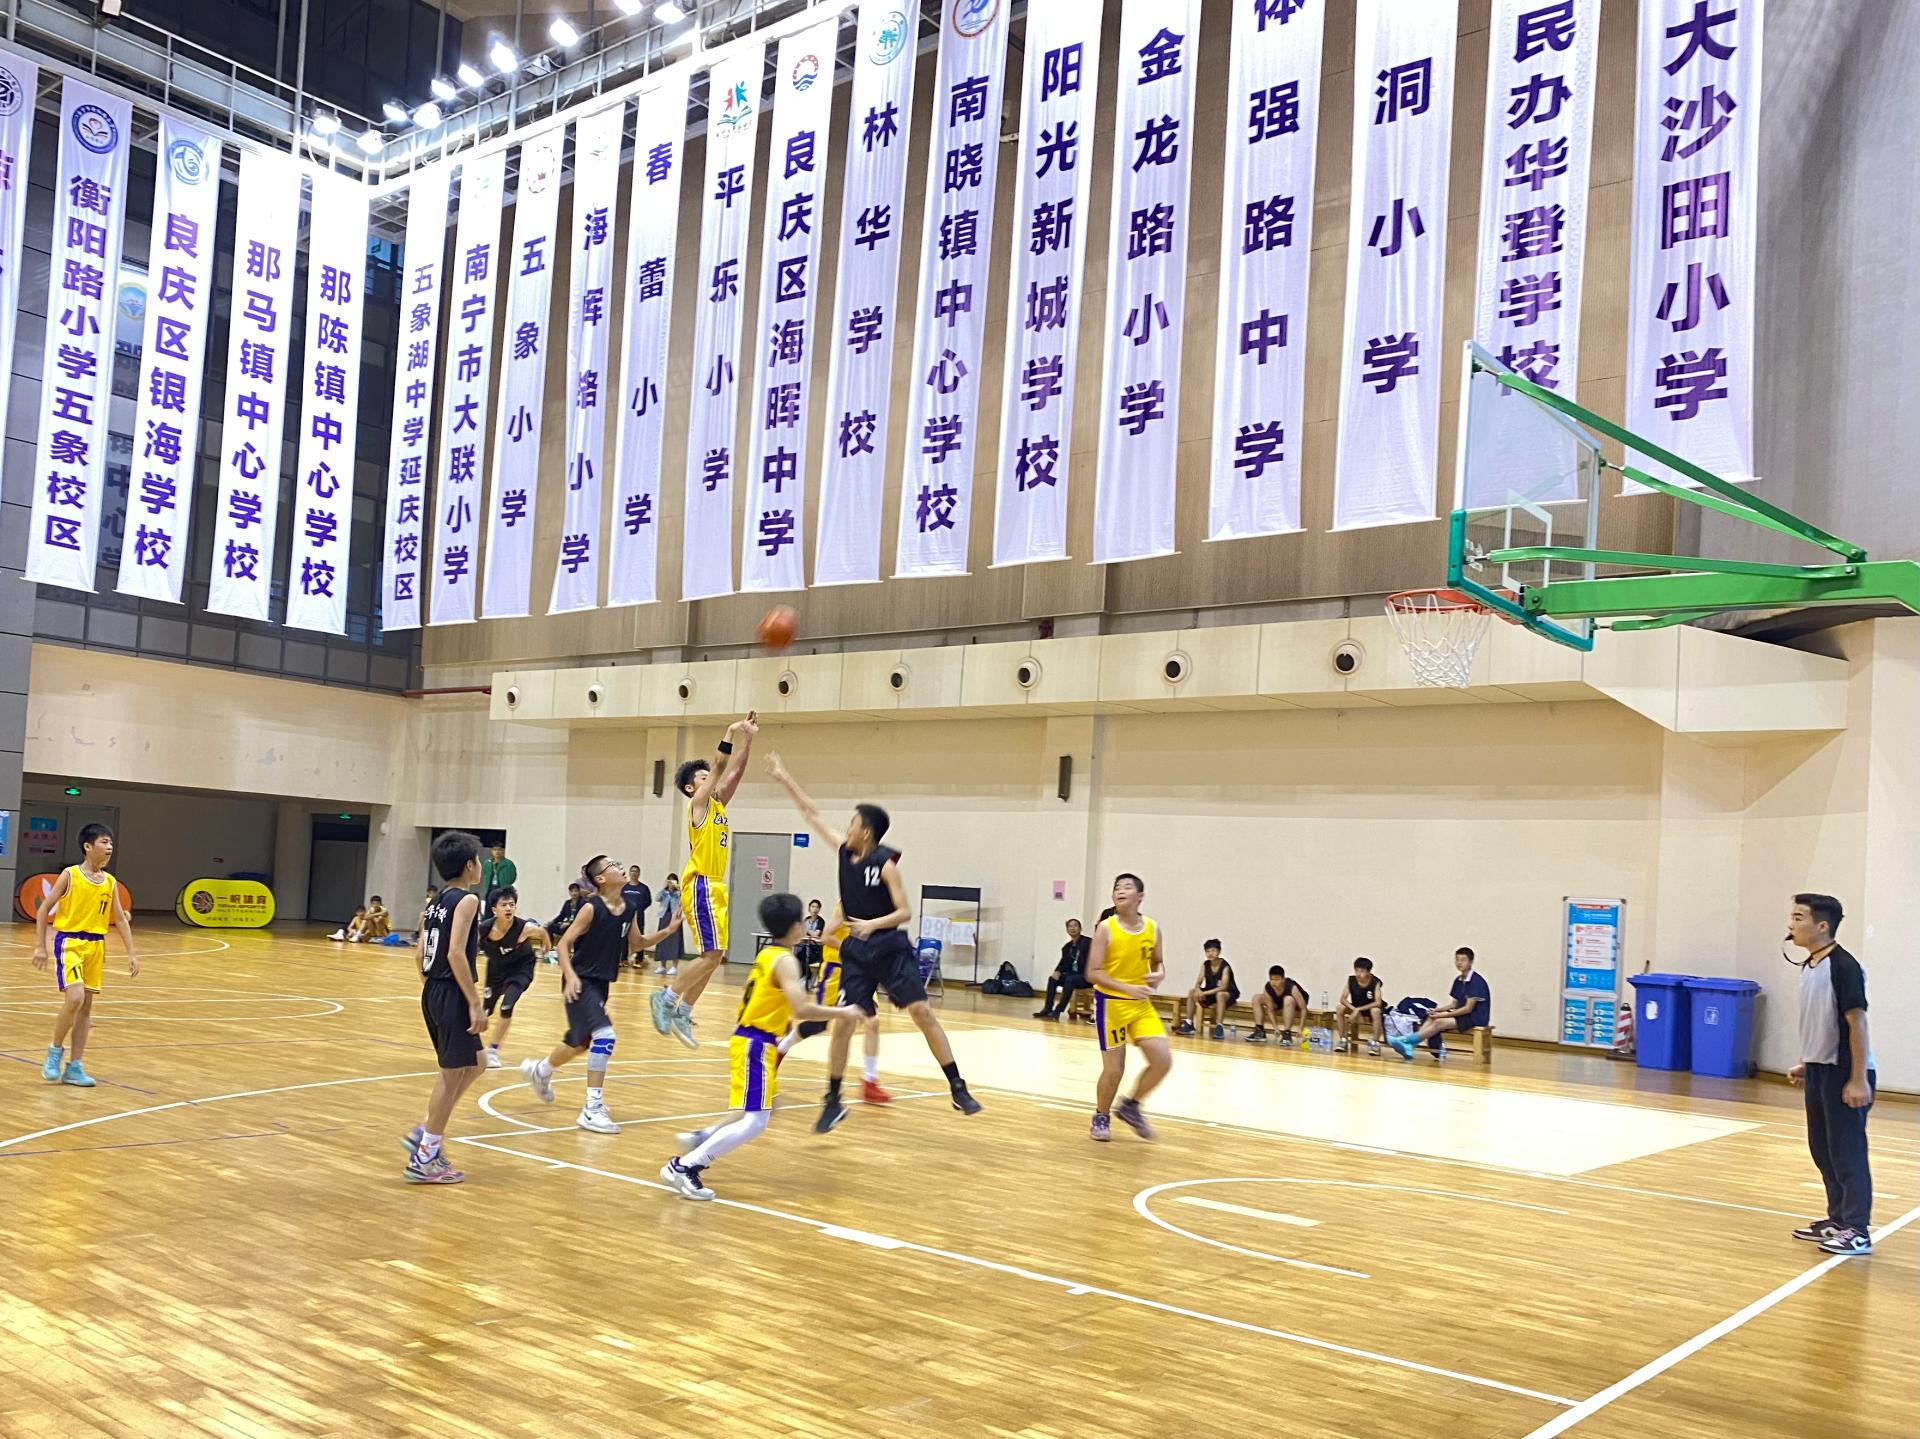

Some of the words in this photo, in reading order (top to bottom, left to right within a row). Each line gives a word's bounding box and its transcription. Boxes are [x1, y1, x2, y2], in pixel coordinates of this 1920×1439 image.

[45, 175, 111, 550] 衡阳路小学五象校区
[624, 143, 672, 535] 春蕾小学
[703, 165, 744, 491] 平乐小学
[758, 131, 814, 556] 良庆区海晖中学
[839, 102, 898, 458] 林华学校
[917, 76, 989, 532] 南晓镇中心学校
[1016, 43, 1082, 491] 阳光新城学校
[1119, 28, 1184, 436] 金龙路小学
[1495, 0, 1575, 396] 民办华登学校
[1654, 0, 1737, 421] 大沙田小学
[135, 213, 197, 569] 良庆区银海学校
[225, 241, 280, 581] 那马镇中心学校
[301, 265, 350, 598] 那陈镇中心学校
[394, 263, 434, 601] 五象湖中学延庆校区
[444, 244, 489, 584] 南宁市大联小学
[501, 237, 545, 527] 五象小学
[99, 901, 107, 915] 11
[864, 866, 880, 886] 12
[1111, 1027, 1126, 1043] 13
